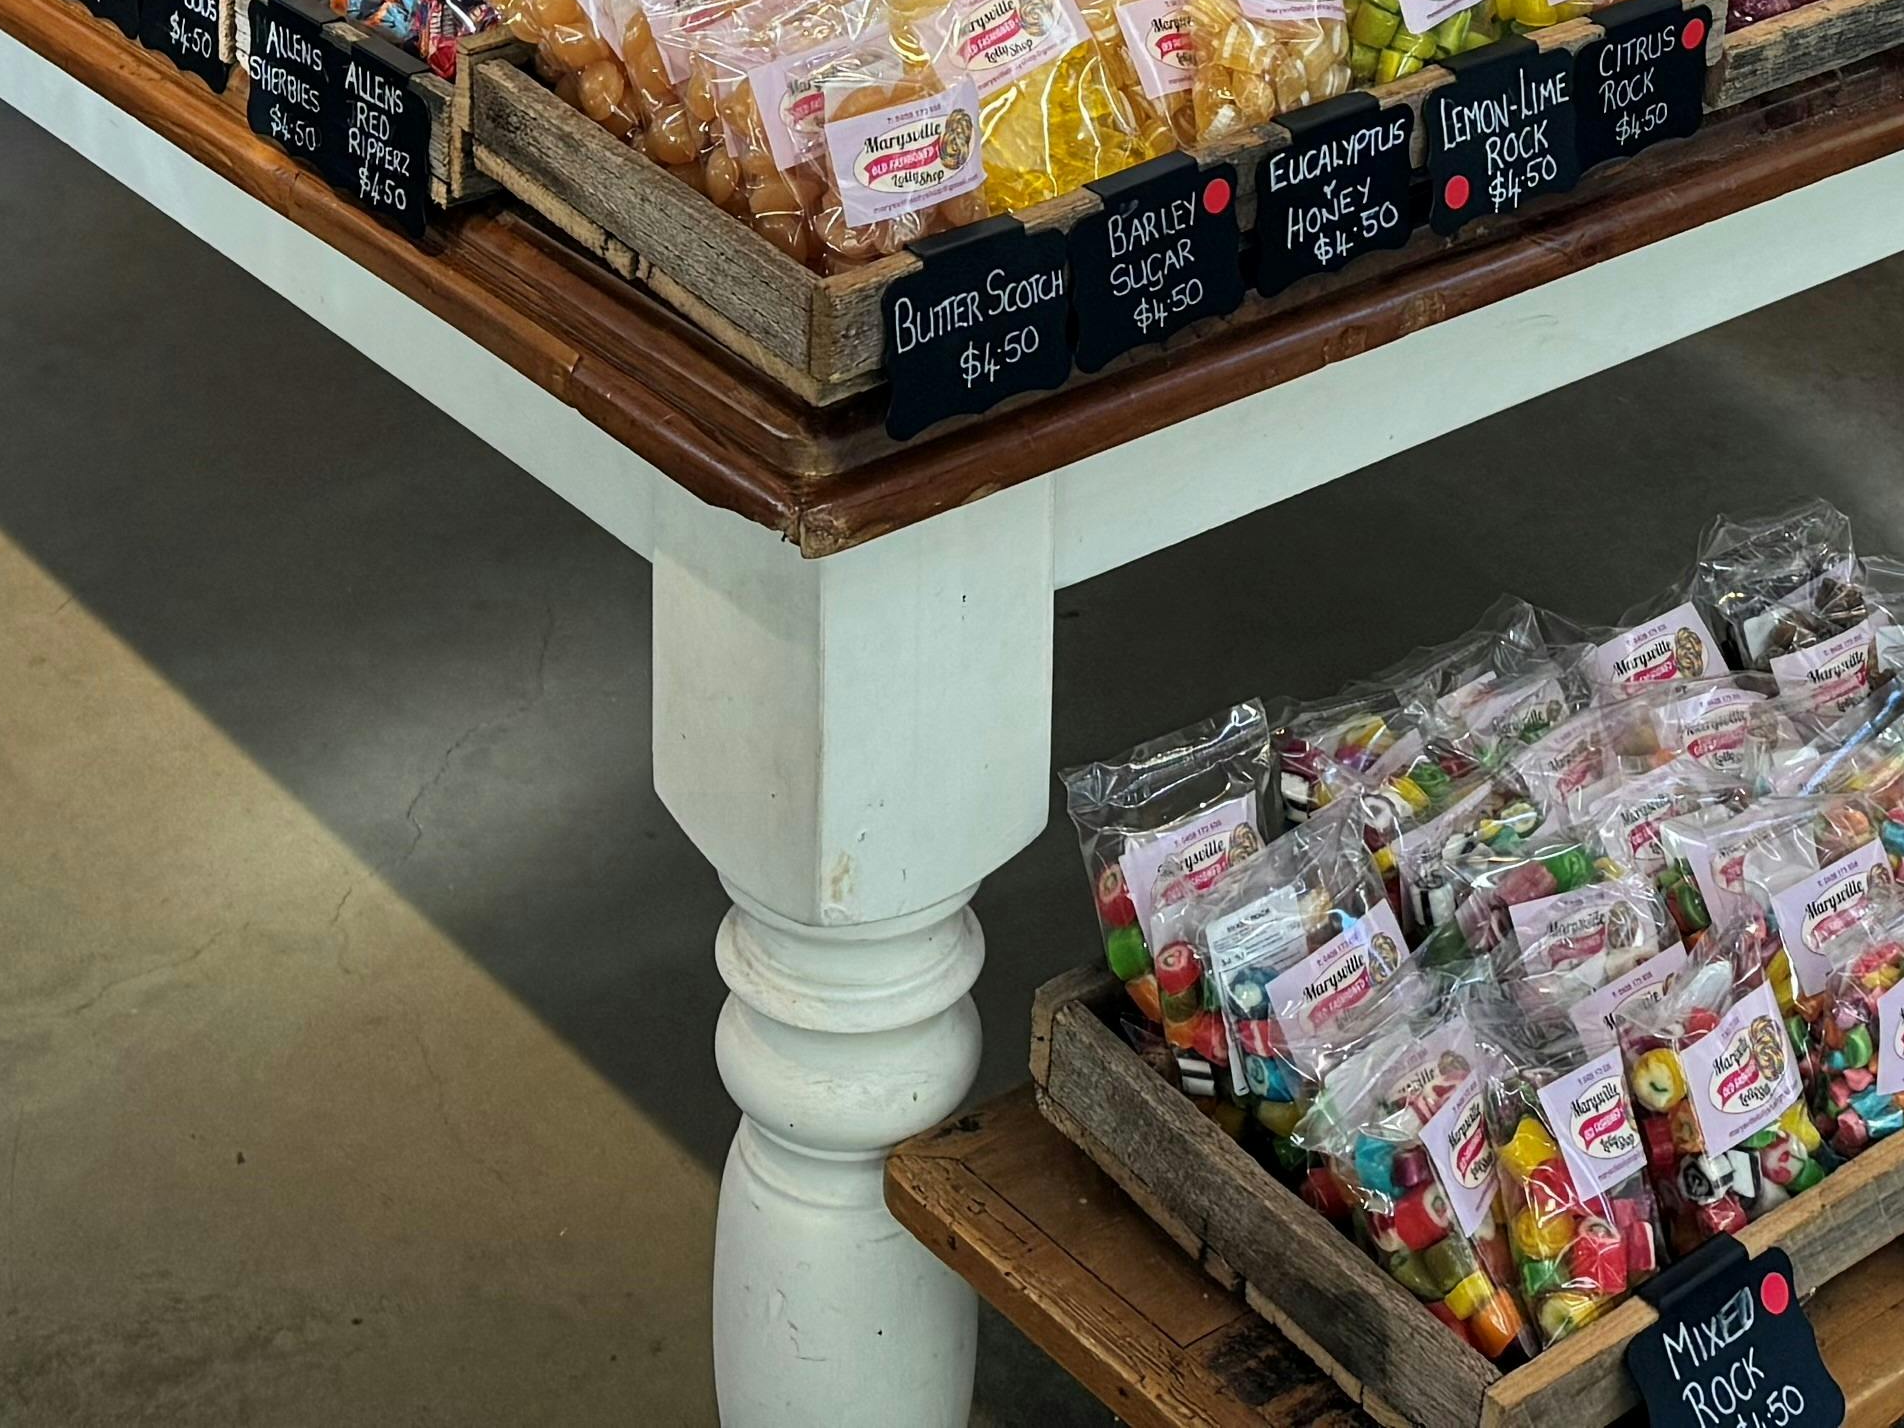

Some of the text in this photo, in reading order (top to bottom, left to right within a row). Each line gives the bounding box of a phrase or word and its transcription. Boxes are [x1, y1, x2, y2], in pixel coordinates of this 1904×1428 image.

[266, 21, 323, 72] ALLENS
[1598, 24, 1676, 78] CITRUS
[249, 56, 321, 114] SHERBIES
[344, 60, 404, 114] ALLENS
[1440, 66, 1571, 153] LEMON-LIME
[1598, 67, 1655, 115] ROCK
[355, 100, 391, 141] RED
[865, 122, 941, 154] Marysville
[1484, 119, 1552, 174] ROCK
[348, 127, 410, 178] RIPPERZ
[872, 146, 934, 176] OLD FASHIONED
[1268, 105, 1407, 194] EUCALYPTUS
[891, 170, 944, 188] Lolly Shop
[1106, 191, 1199, 261] BARLEY
[1284, 175, 1374, 250] HONEY
[1108, 238, 1198, 297] SUGAR
[893, 267, 1066, 356] BUTTER SCOTCH
[1661, 1285, 1757, 1382] MIXED
